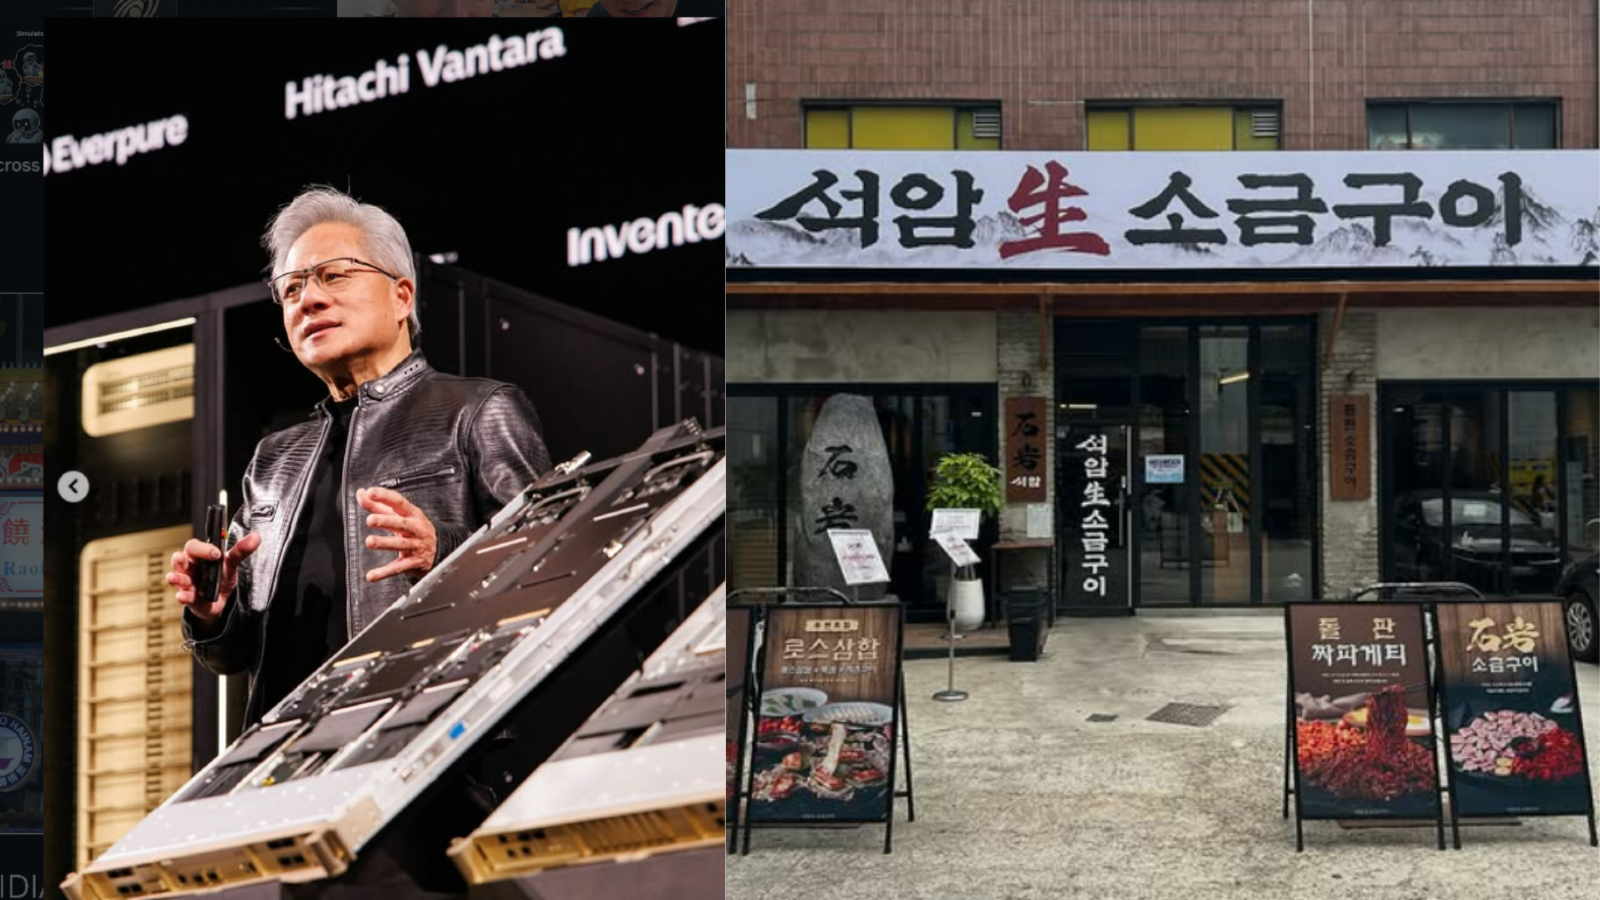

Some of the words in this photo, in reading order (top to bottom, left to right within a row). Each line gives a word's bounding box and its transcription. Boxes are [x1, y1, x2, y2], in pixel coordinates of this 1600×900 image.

[285, 53, 409, 119] Hitachi
[416, 26, 567, 87] Vantara
[52, 114, 188, 173] Everpure
[1124, 169, 1523, 247] 소금구이
[1011, 475, 1041, 488] 석암
[1075, 434, 1111, 596] 석암生소금구이
[783, 637, 881, 661] 로스삼합
[1466, 616, 1540, 653] 石岩
[1311, 643, 1407, 667] 짜파게티
[1472, 656, 1539, 673] 소금구이
